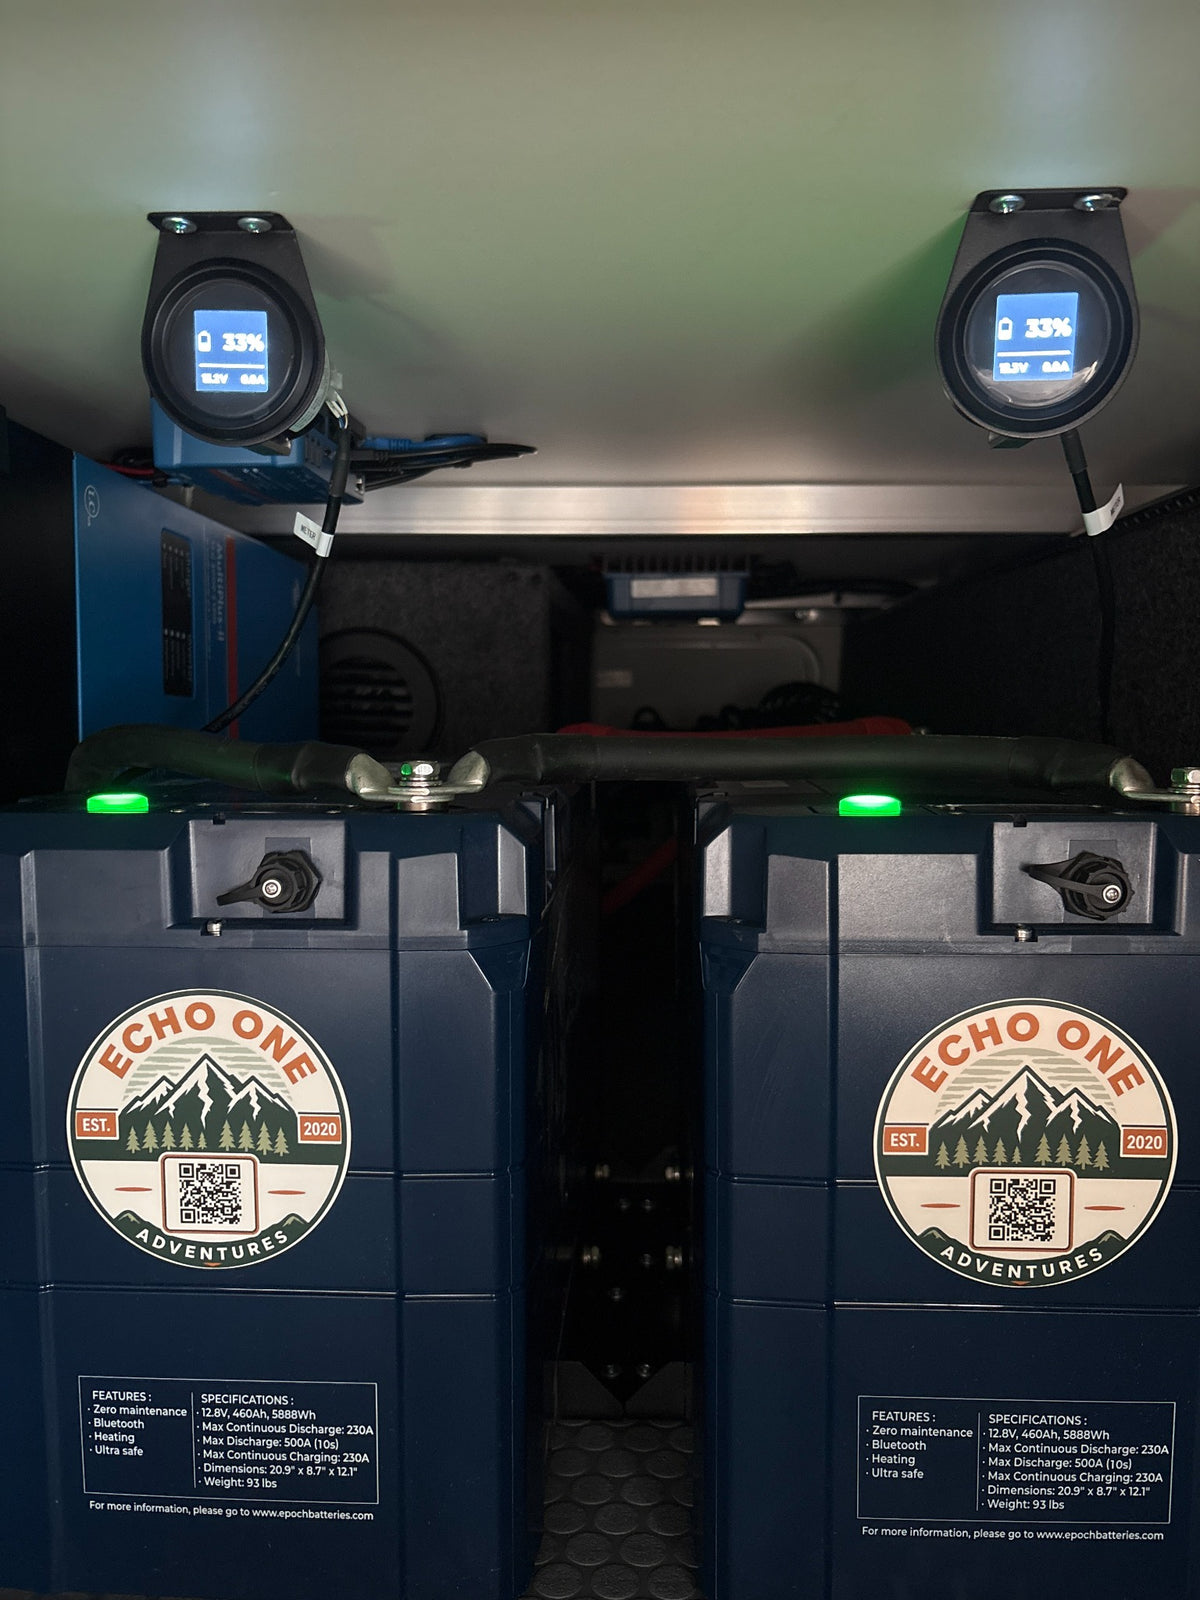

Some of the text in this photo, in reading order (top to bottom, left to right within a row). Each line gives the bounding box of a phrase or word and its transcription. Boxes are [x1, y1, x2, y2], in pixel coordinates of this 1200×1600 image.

[1025, 317, 1073, 338] 33%
[222, 333, 265, 352] 33%
[301, 524, 316, 540] METER
[98, 1002, 318, 1084] ECHO ONE
[911, 1012, 1145, 1097] ECHO ONE
[82, 1118, 110, 1132] EST.
[304, 1122, 337, 1136] 2020
[890, 1133, 920, 1147] EST.
[1127, 1135, 1162, 1150] 2020
[136, 1228, 288, 1260] ADVENTURES
[940, 1247, 1102, 1279] ADVENTURES
[93, 1390, 146, 1401] FEATURES
[201, 1394, 288, 1405] SPECIFICATIONS
[93, 1404, 187, 1416] Zero maintenance
[201, 1407, 316, 1420] 12.8V, 460Ah, 5888Wh
[872, 1411, 930, 1422] FEATURES
[94, 1418, 144, 1429] Bluetooth
[989, 1414, 1081, 1425] SPECIFICATIONS
[202, 1422, 374, 1436] Max Continuous Discharge: 230A
[873, 1425, 973, 1437] Zero maintenance
[988, 1428, 1109, 1441] 12.8V, 460Ah, 5888Wh
[94, 1431, 135, 1444] Heating
[203, 1436, 339, 1450] Max Discharge: 500A (10s)
[95, 1445, 143, 1456] Ultra safe
[872, 1439, 926, 1450] Bluetooth
[989, 1443, 1169, 1456] Max Continuous Discharge: 230A
[203, 1449, 369, 1464] Max Continuous Charging: 230A
[872, 1454, 915, 1467] Heating
[204, 1462, 267, 1474] Dimensions:
[269, 1465, 295, 1475] 20.9"
[306, 1466, 326, 1475] 8.7"
[337, 1467, 357, 1476] 12.1"
[989, 1457, 1132, 1470] Max Discharge: 500A (10s)
[872, 1468, 924, 1479] Ultra safe
[988, 1471, 1163, 1484] Max Continuous Charging: 230A
[204, 1476, 277, 1489] Weight: 93 lbs
[988, 1485, 1055, 1495] Dimensions:
[1058, 1486, 1085, 1496] 20.9"
[1087, 1488, 1093, 1496] x
[1096, 1486, 1117, 1496] 8.7"
[1129, 1487, 1150, 1496] 12.1"
[90, 1500, 374, 1520] For more information, please go to www.epochbatteries.com
[987, 1499, 1064, 1511] Weight: 93 lbs
[862, 1526, 878, 1535] For
[910, 1527, 971, 1539] information,
[974, 1529, 1006, 1539] please
[1008, 1531, 1021, 1540] go
[1024, 1531, 1034, 1539] to
[1036, 1530, 1164, 1541] www.epochbatteries.com
